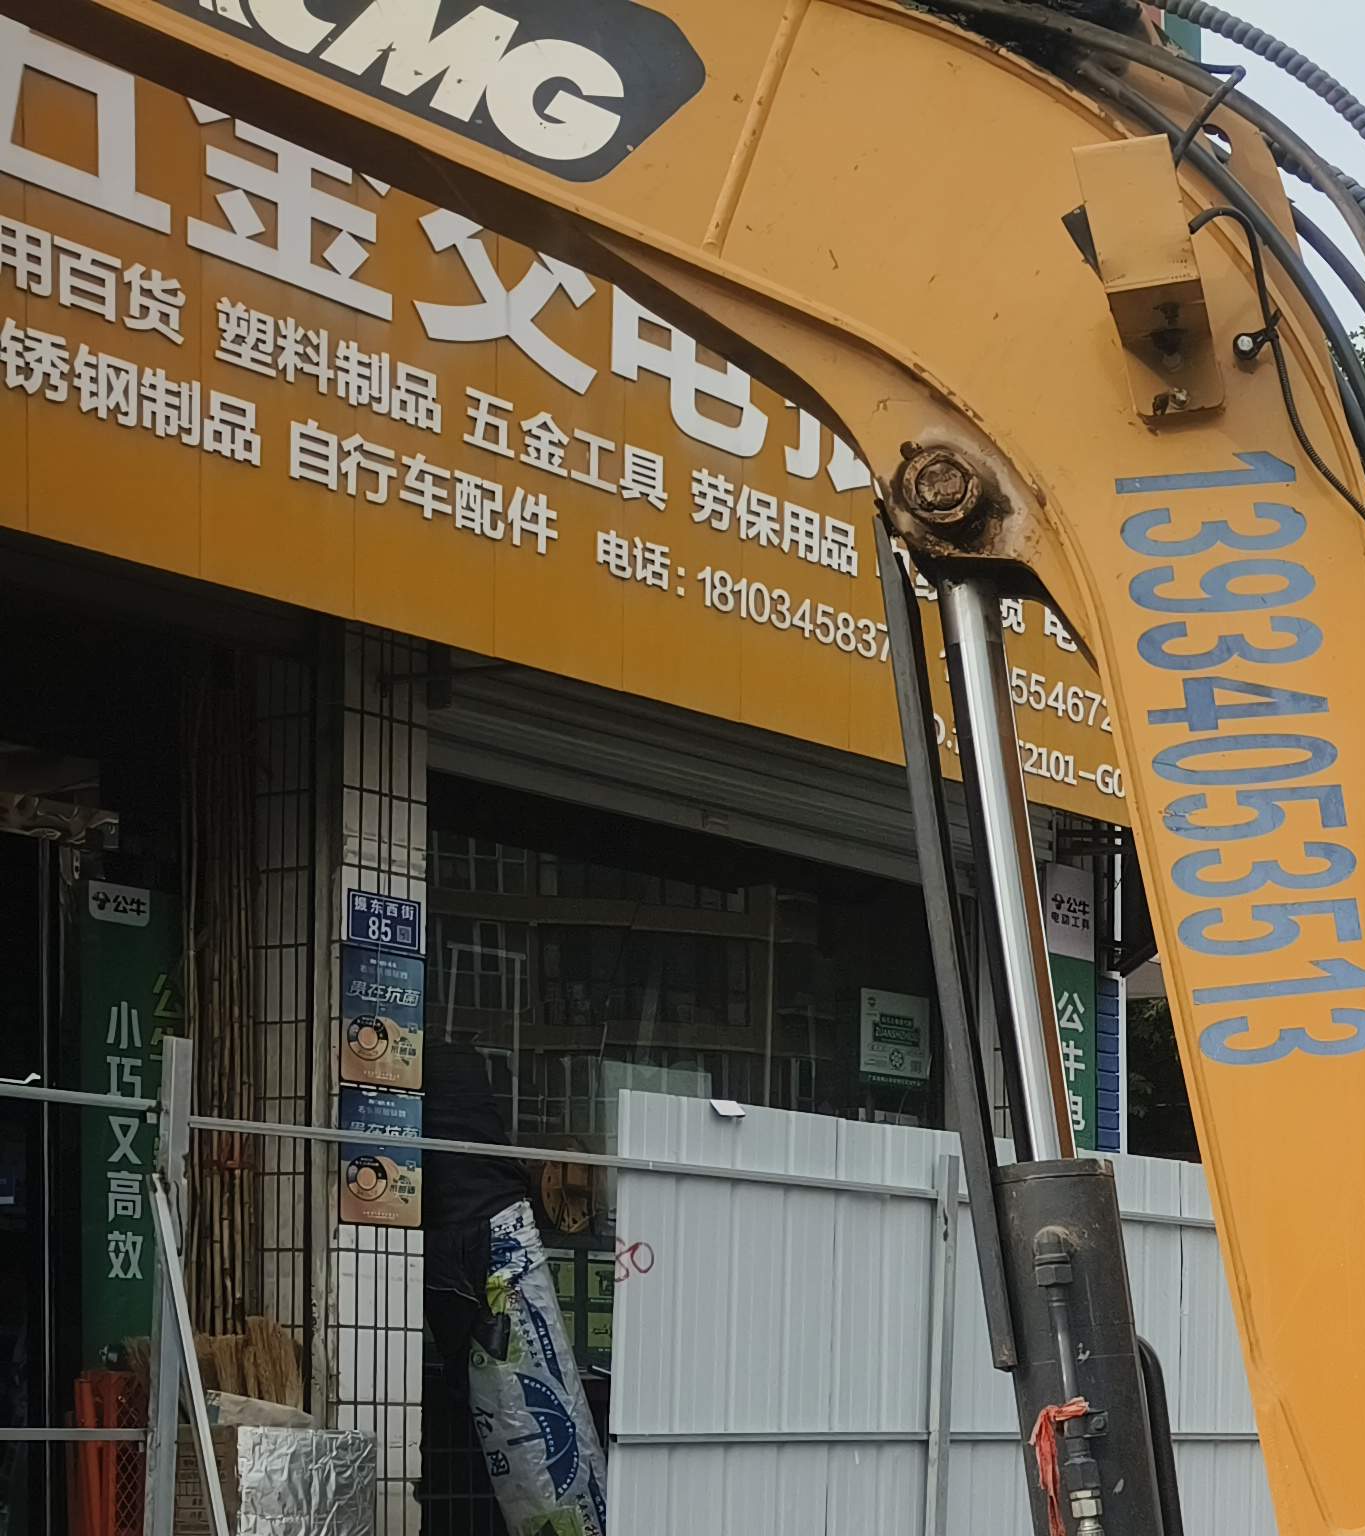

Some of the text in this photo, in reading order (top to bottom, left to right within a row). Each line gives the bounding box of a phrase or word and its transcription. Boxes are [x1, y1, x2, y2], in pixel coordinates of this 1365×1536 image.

[0, 317, 559, 555] 锈钢制品 自行车配件
[215, 297, 442, 435] 塑料制品
[463, 386, 669, 511] 五金工具
[691, 468, 859, 578] 劳保用品
[368, 916, 391, 942] 85
[106, 1001, 144, 1281] 小巧又高效
